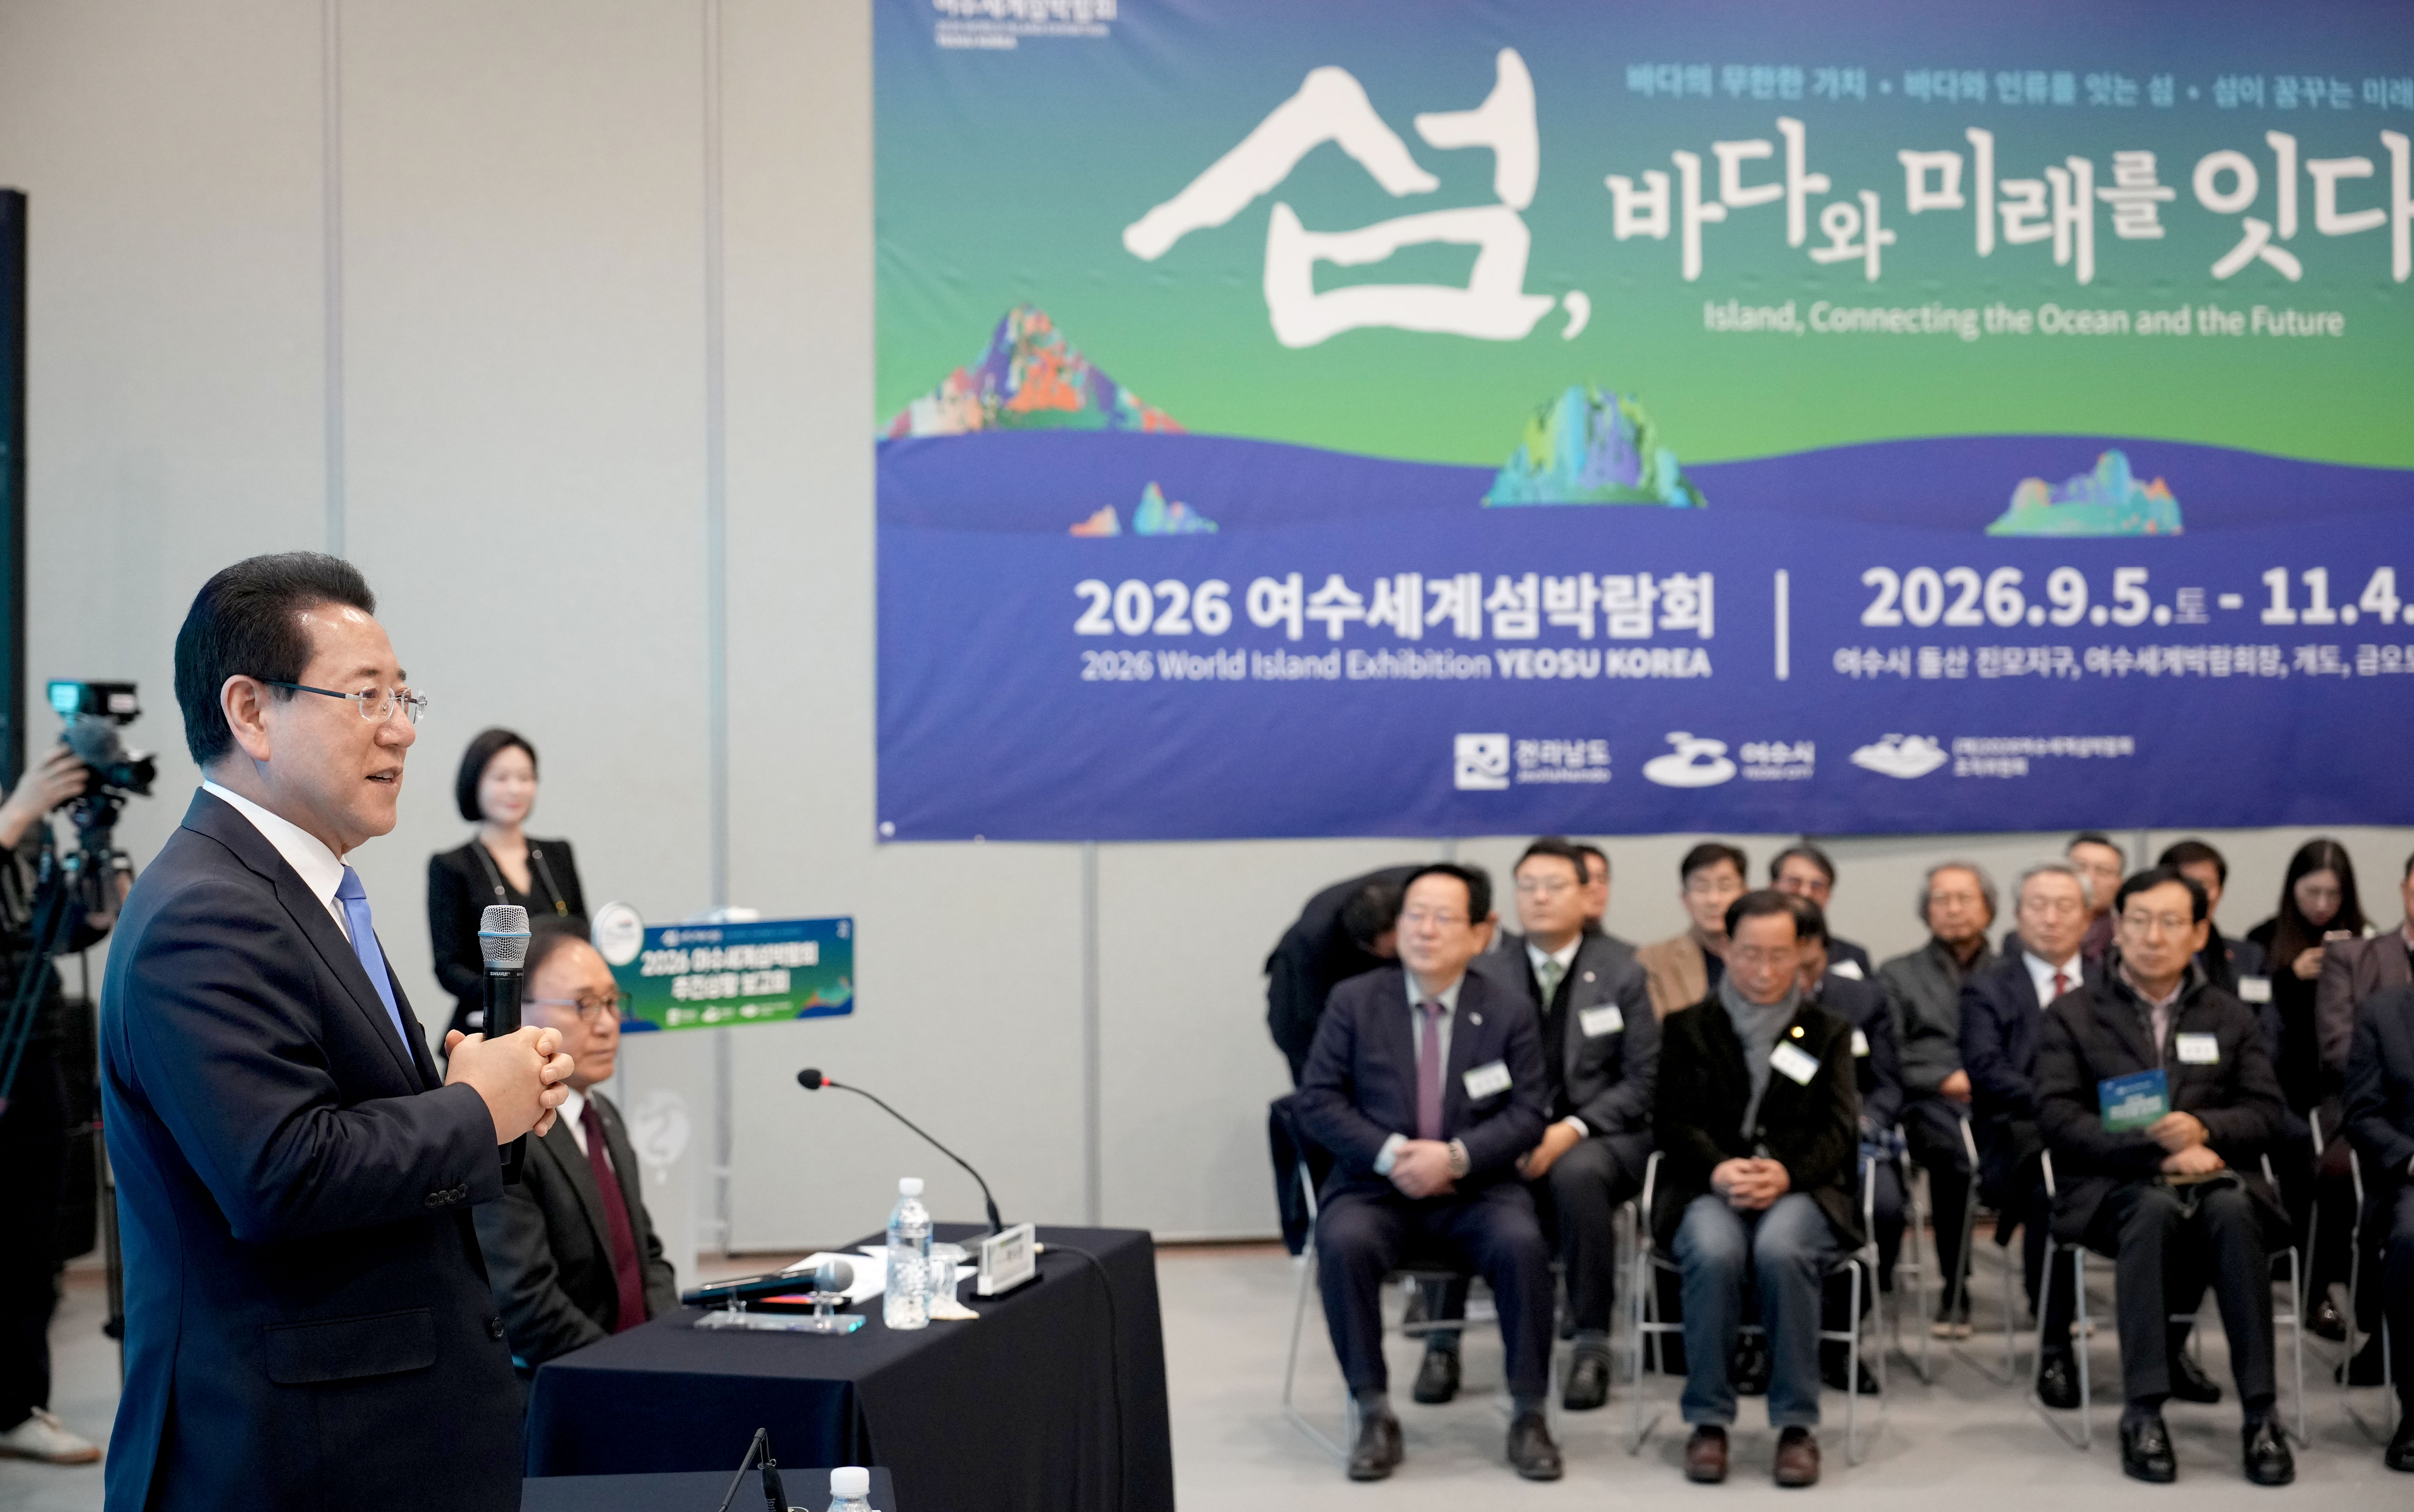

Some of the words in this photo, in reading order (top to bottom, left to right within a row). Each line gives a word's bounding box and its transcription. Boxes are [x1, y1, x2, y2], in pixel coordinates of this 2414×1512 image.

[1627, 64, 1712, 98] 바다의
[1812, 67, 1866, 101] 가치
[1903, 69, 1987, 103] 바다와
[1994, 71, 2076, 105] 인류를
[2148, 74, 2174, 107] 섬
[2213, 75, 2264, 108] 섬이
[2273, 76, 2352, 109] 꿈꾸는
[2362, 77, 2414, 110] 미래
[1122, 49, 1591, 348] 섬,
[1605, 118, 1896, 282] 바다와
[1898, 128, 2175, 283] 미래를
[2193, 130, 2414, 282] 잇다
[1704, 300, 1805, 335] Island,
[1809, 301, 1978, 341] Connecting
[1983, 303, 2032, 334] the
[2037, 303, 2130, 334] Ocean
[2135, 305, 2191, 335] and
[2197, 305, 2246, 335] the
[2251, 305, 2344, 336] Future
[1075, 580, 1231, 635] 2026
[1246, 573, 1713, 640] 여수세계섬박람회
[1082, 651, 1154, 680] 2026
[1157, 649, 1246, 680] World
[1252, 649, 1341, 680] Island
[1346, 649, 1491, 679] Exhibition
[1496, 649, 1601, 678] YEOSU
[1606, 648, 1712, 678] KOREA
[1834, 647, 1910, 677] 여수시
[1918, 647, 1968, 678] 돌산
